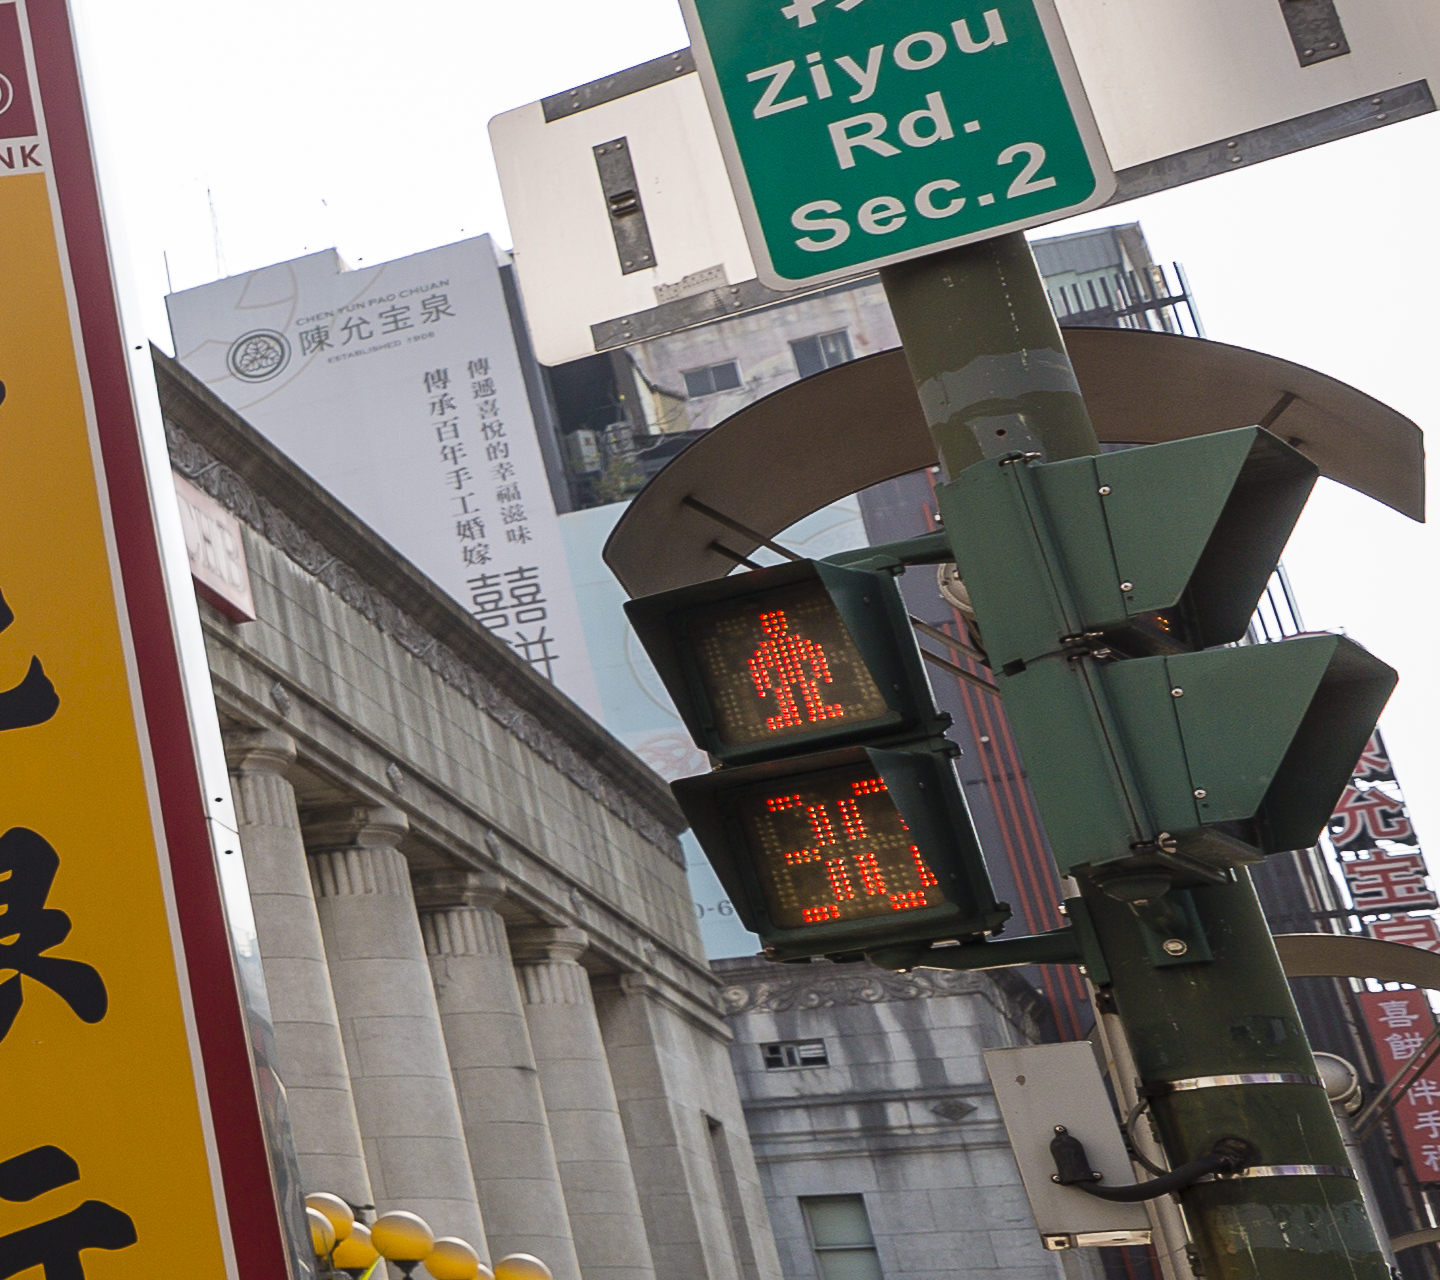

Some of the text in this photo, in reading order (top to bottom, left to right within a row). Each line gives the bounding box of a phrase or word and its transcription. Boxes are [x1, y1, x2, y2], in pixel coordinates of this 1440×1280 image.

[745, 7, 1010, 119] Ziyou
[827, 89, 982, 172] Rd.
[790, 140, 1057, 254] Sec.2
[296, 278, 450, 326] CHEN YUN PAO CHUAN
[298, 293, 457, 357] 陳允宝泉
[327, 338, 402, 364] ESTABLISHED
[423, 367, 492, 569] 傳承百年手工婚嫁
[467, 357, 532, 545] 傳遞喜悅的幸福滋味
[767, 777, 938, 922] 30
